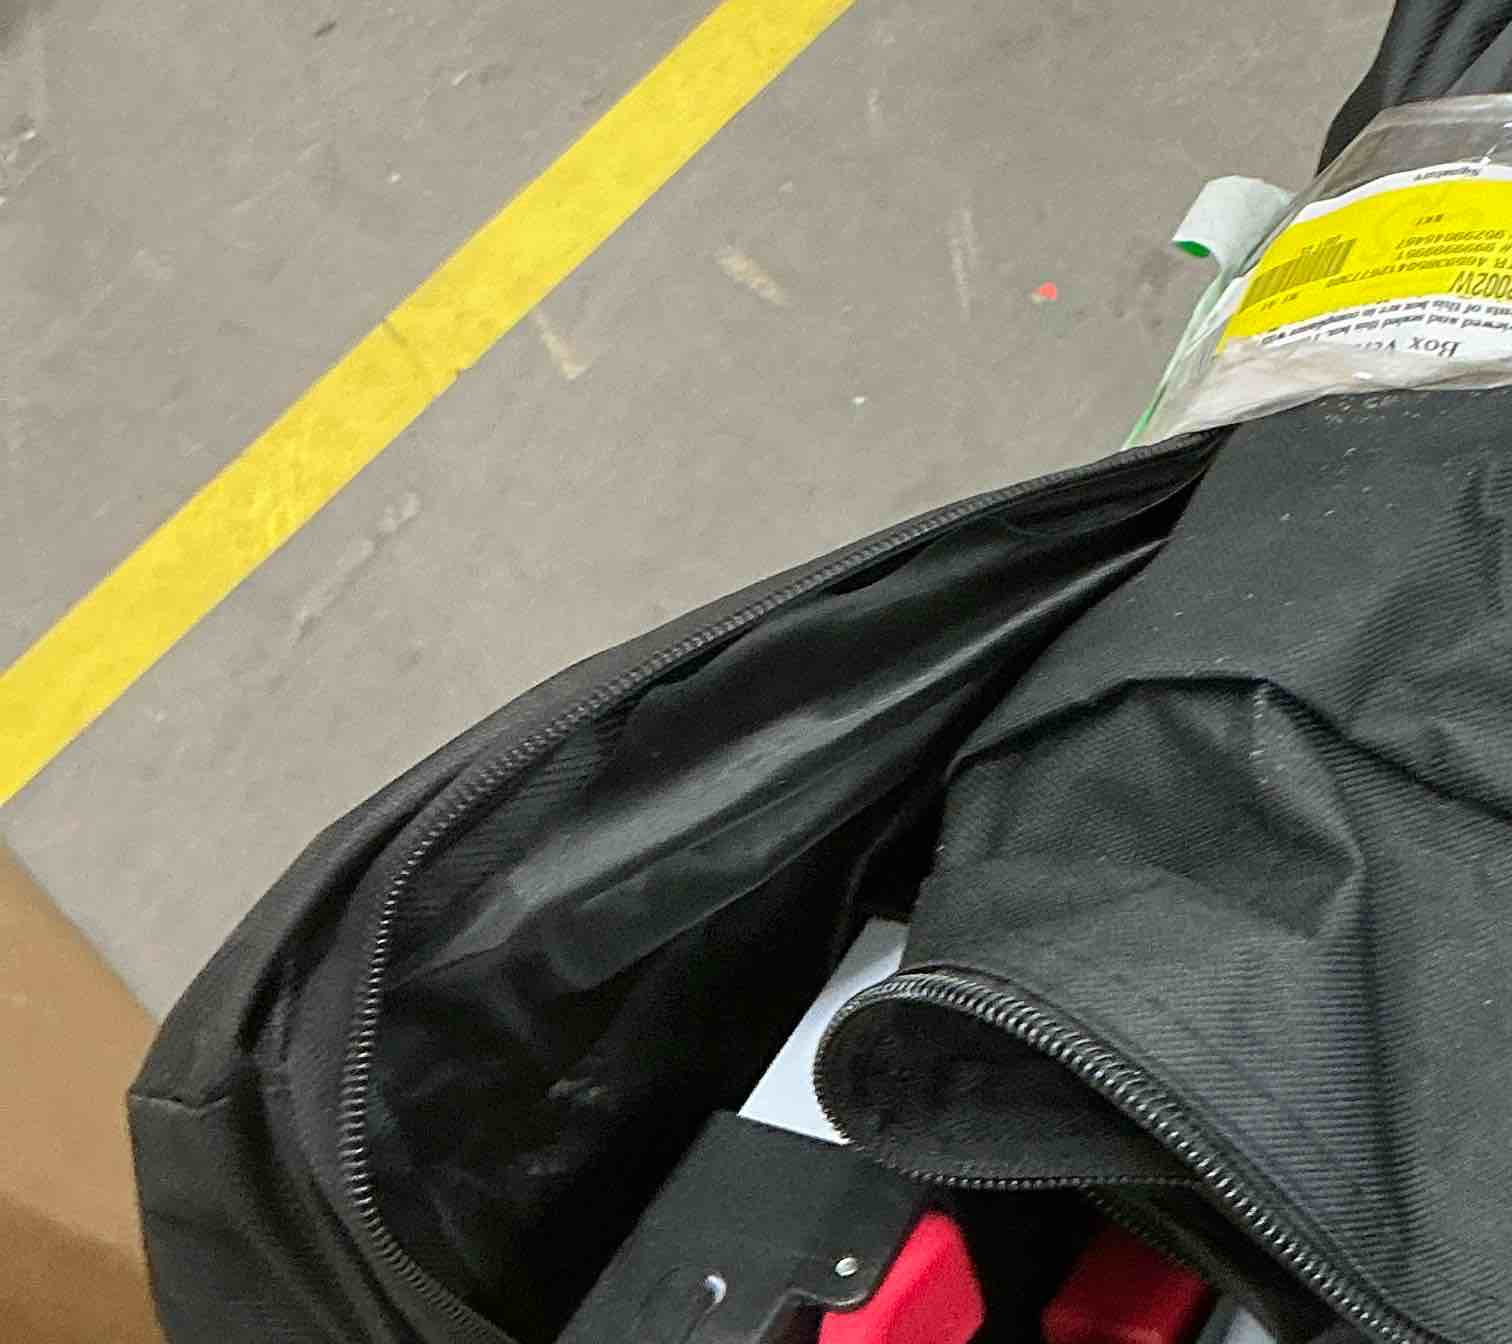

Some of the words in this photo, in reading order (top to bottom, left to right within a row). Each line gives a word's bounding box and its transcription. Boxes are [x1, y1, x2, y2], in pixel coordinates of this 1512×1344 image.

[1432, 300, 1462, 312] this
[1463, 303, 1482, 315] of
[1427, 314, 1458, 326] and
[1408, 336, 1460, 358] Box
